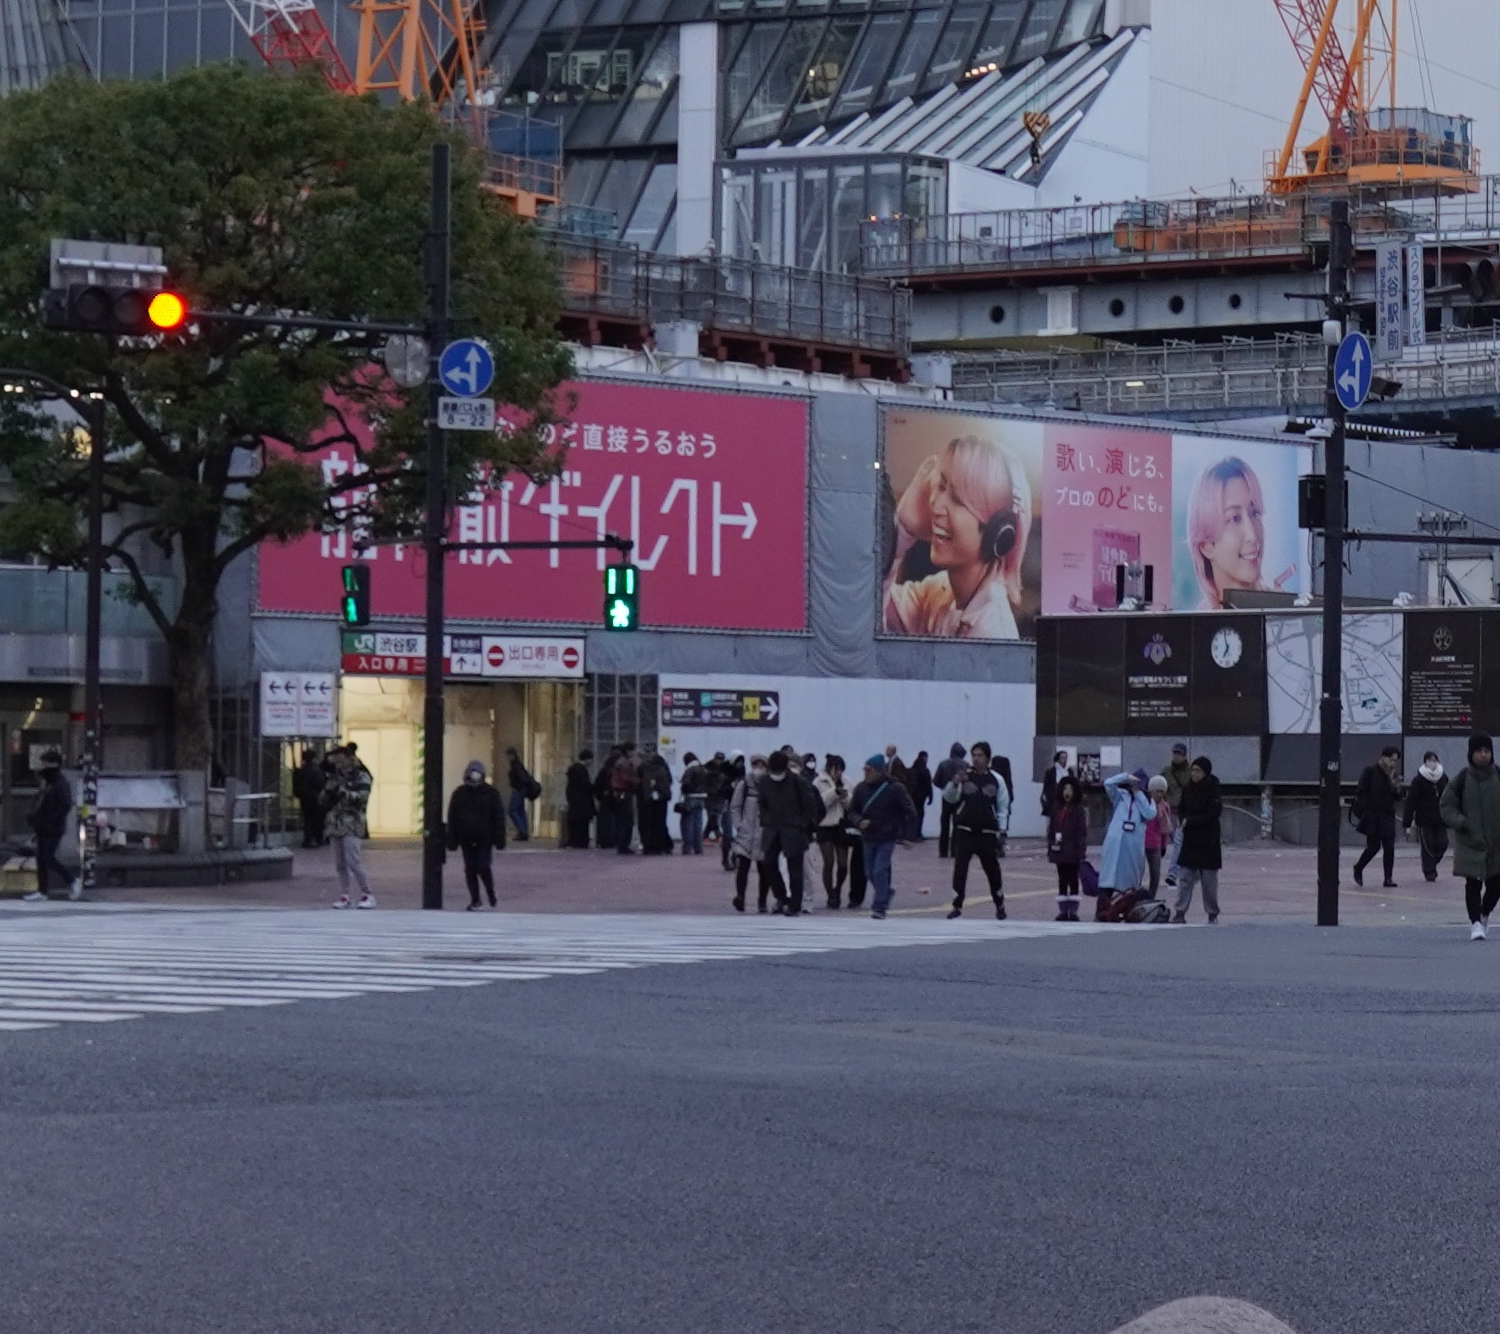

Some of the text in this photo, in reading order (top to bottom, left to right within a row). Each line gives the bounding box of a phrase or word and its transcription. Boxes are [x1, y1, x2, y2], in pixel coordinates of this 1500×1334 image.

[1387, 249, 1399, 351] 渋谷駅前
[1411, 247, 1421, 343] スクランブル式
[1054, 443, 1165, 479] 歌い、演じる、
[1054, 484, 1165, 514] プロののどにも。
[355, 634, 418, 653] JR 渋谷駅
[509, 646, 559, 662] 出口専用
[359, 658, 409, 671] 入口専用
